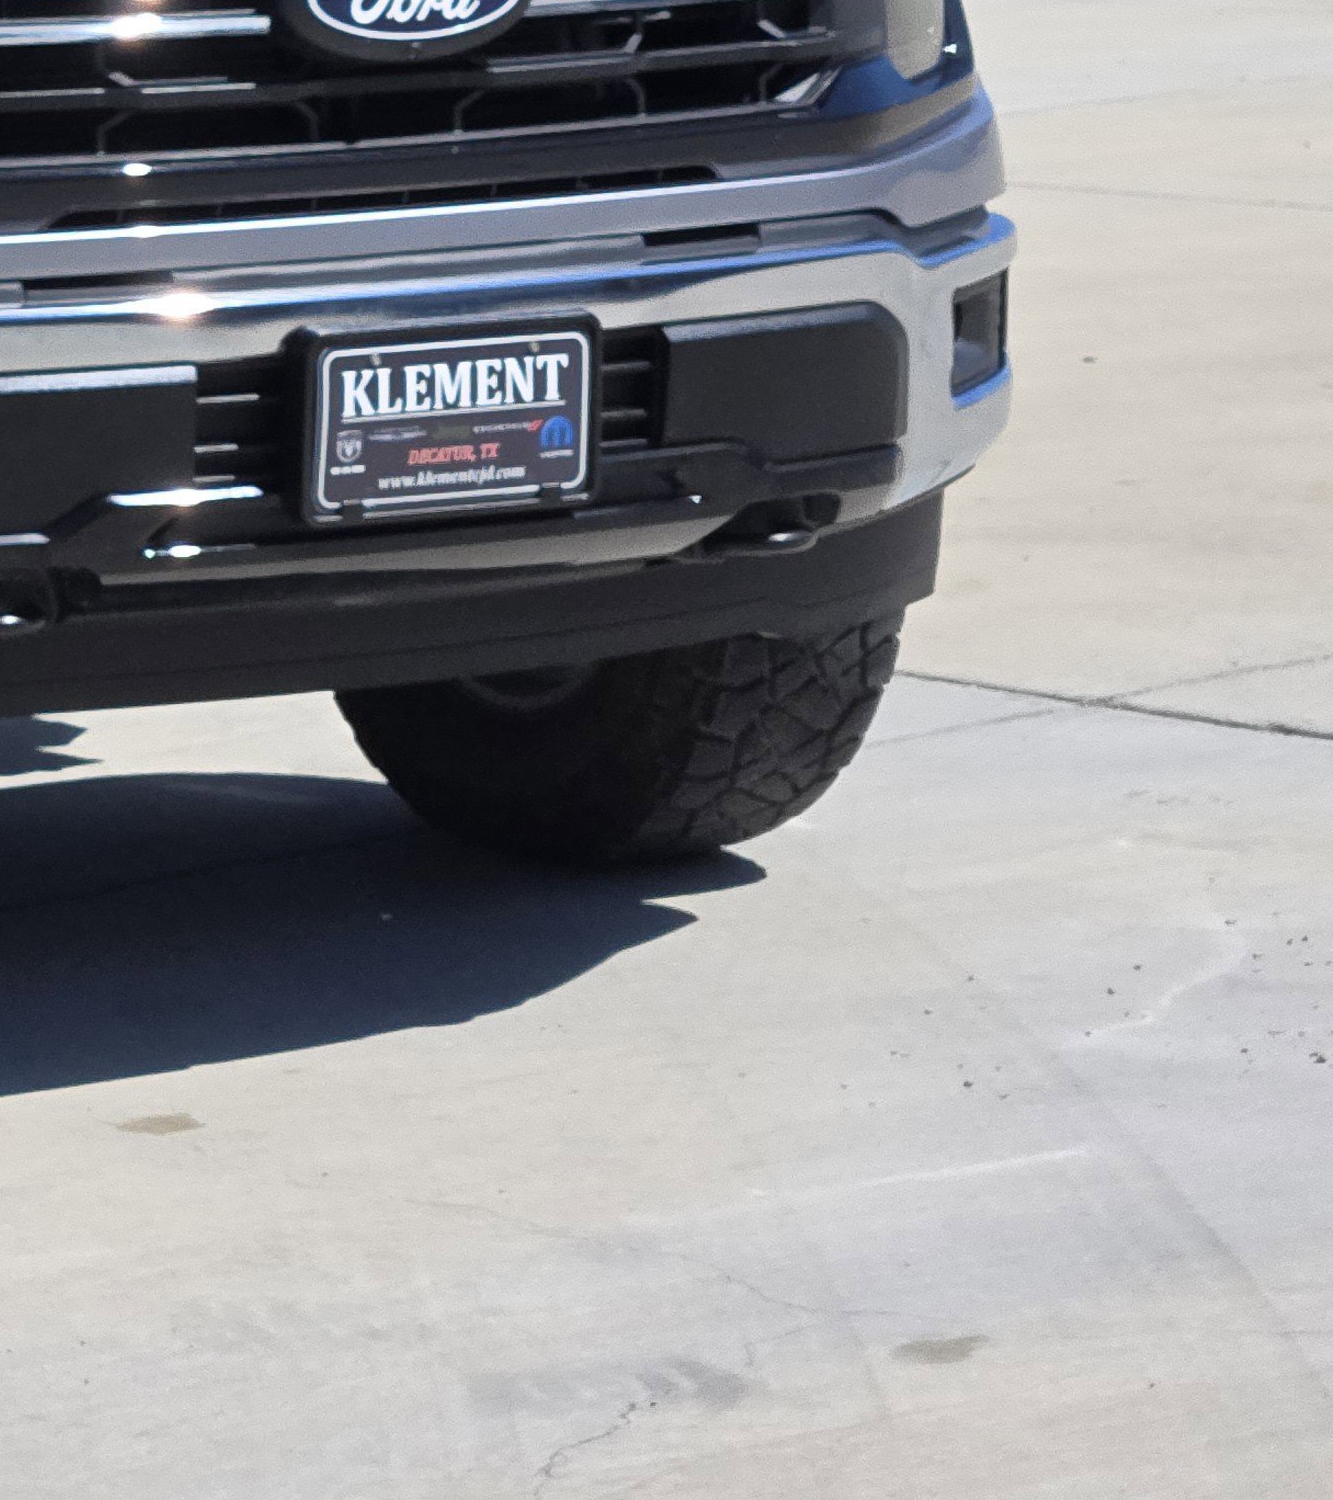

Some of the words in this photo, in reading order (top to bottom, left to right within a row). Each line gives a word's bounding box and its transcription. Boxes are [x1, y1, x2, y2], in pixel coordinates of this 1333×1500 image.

[341, 353, 569, 419] KLEMENT
[407, 444, 476, 466] DECATUR,
[480, 442, 501, 460] TX
